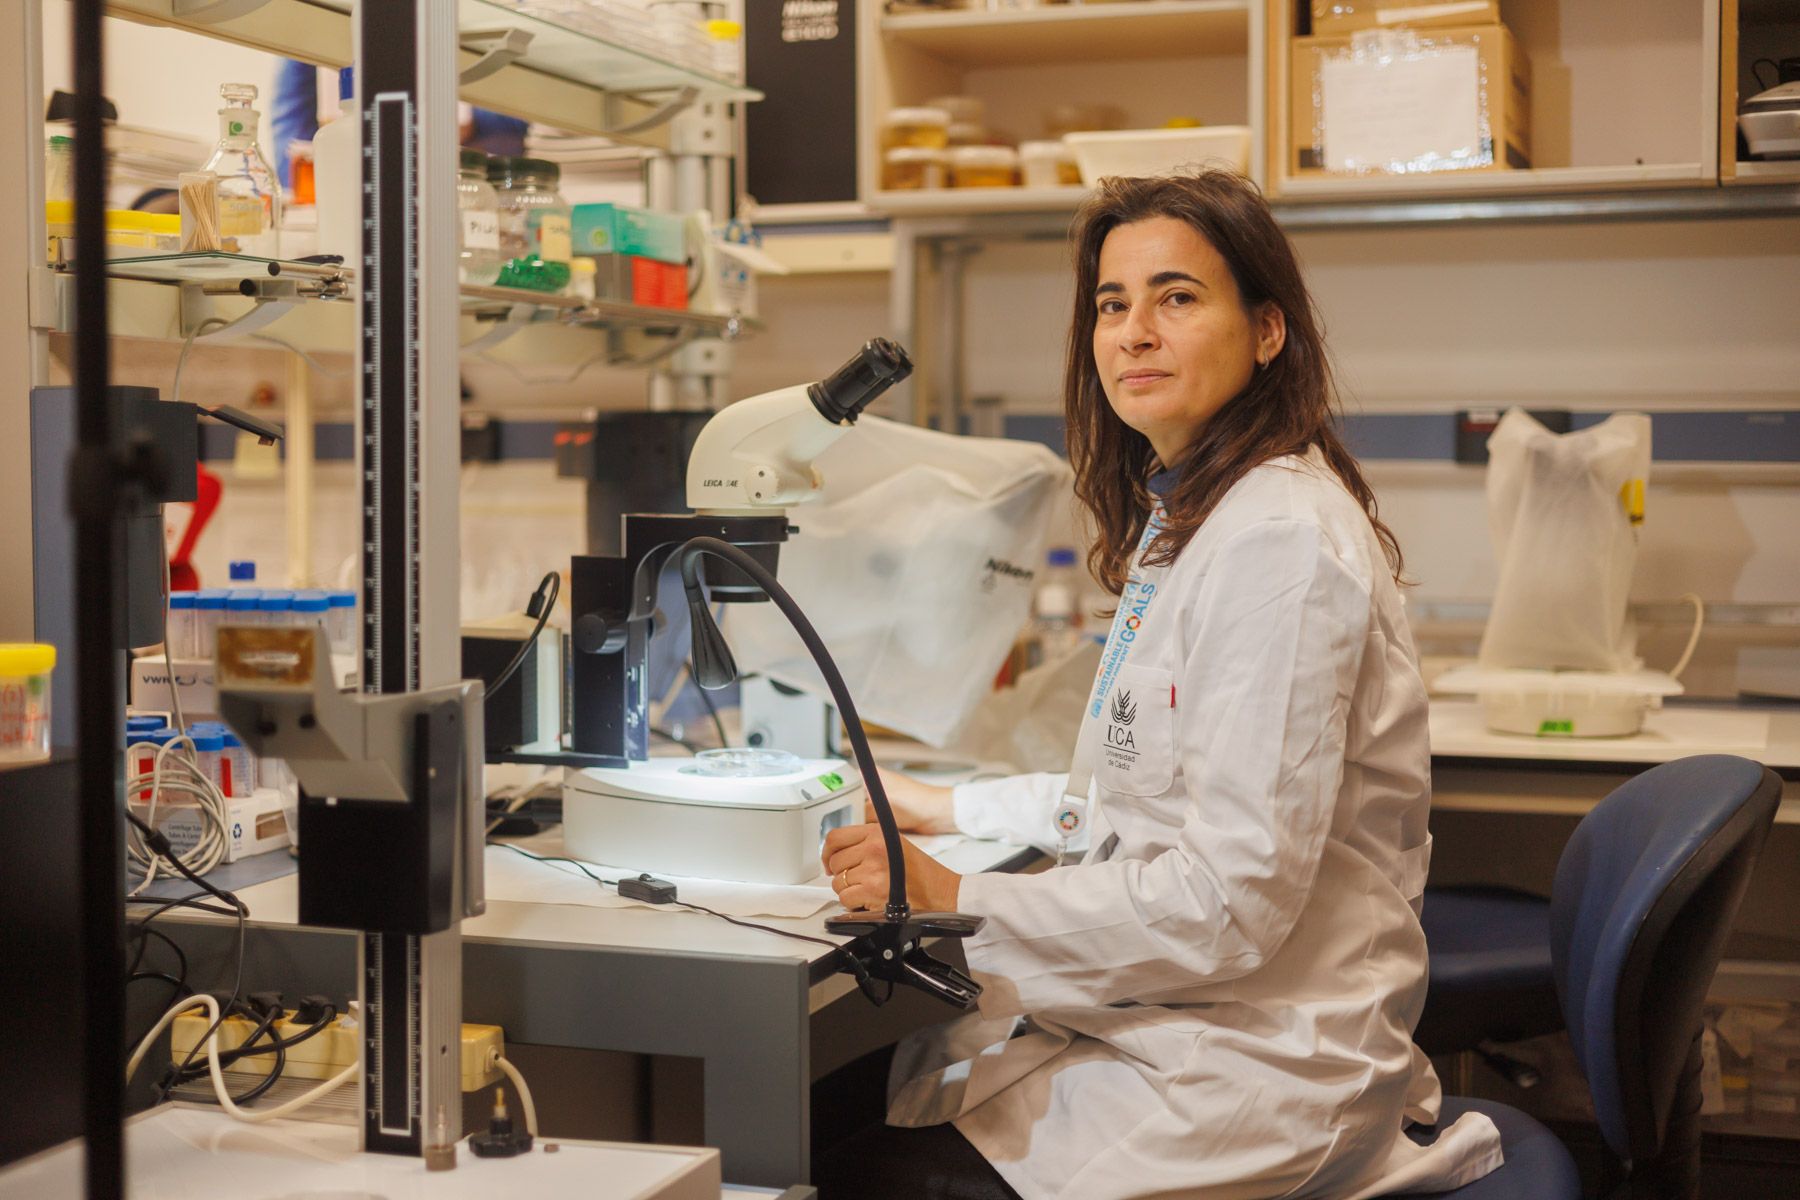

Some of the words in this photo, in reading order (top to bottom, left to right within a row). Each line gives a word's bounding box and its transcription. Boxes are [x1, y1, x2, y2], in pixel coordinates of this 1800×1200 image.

[703, 479, 722, 487] LEICA
[984, 558, 1034, 581] Nikon
[1097, 642, 1124, 696] SUSTAINABLE
[1120, 583, 1155, 643] GOALS
[1107, 724, 1135, 749] UCA
[1105, 749, 1136, 762] Universidad
